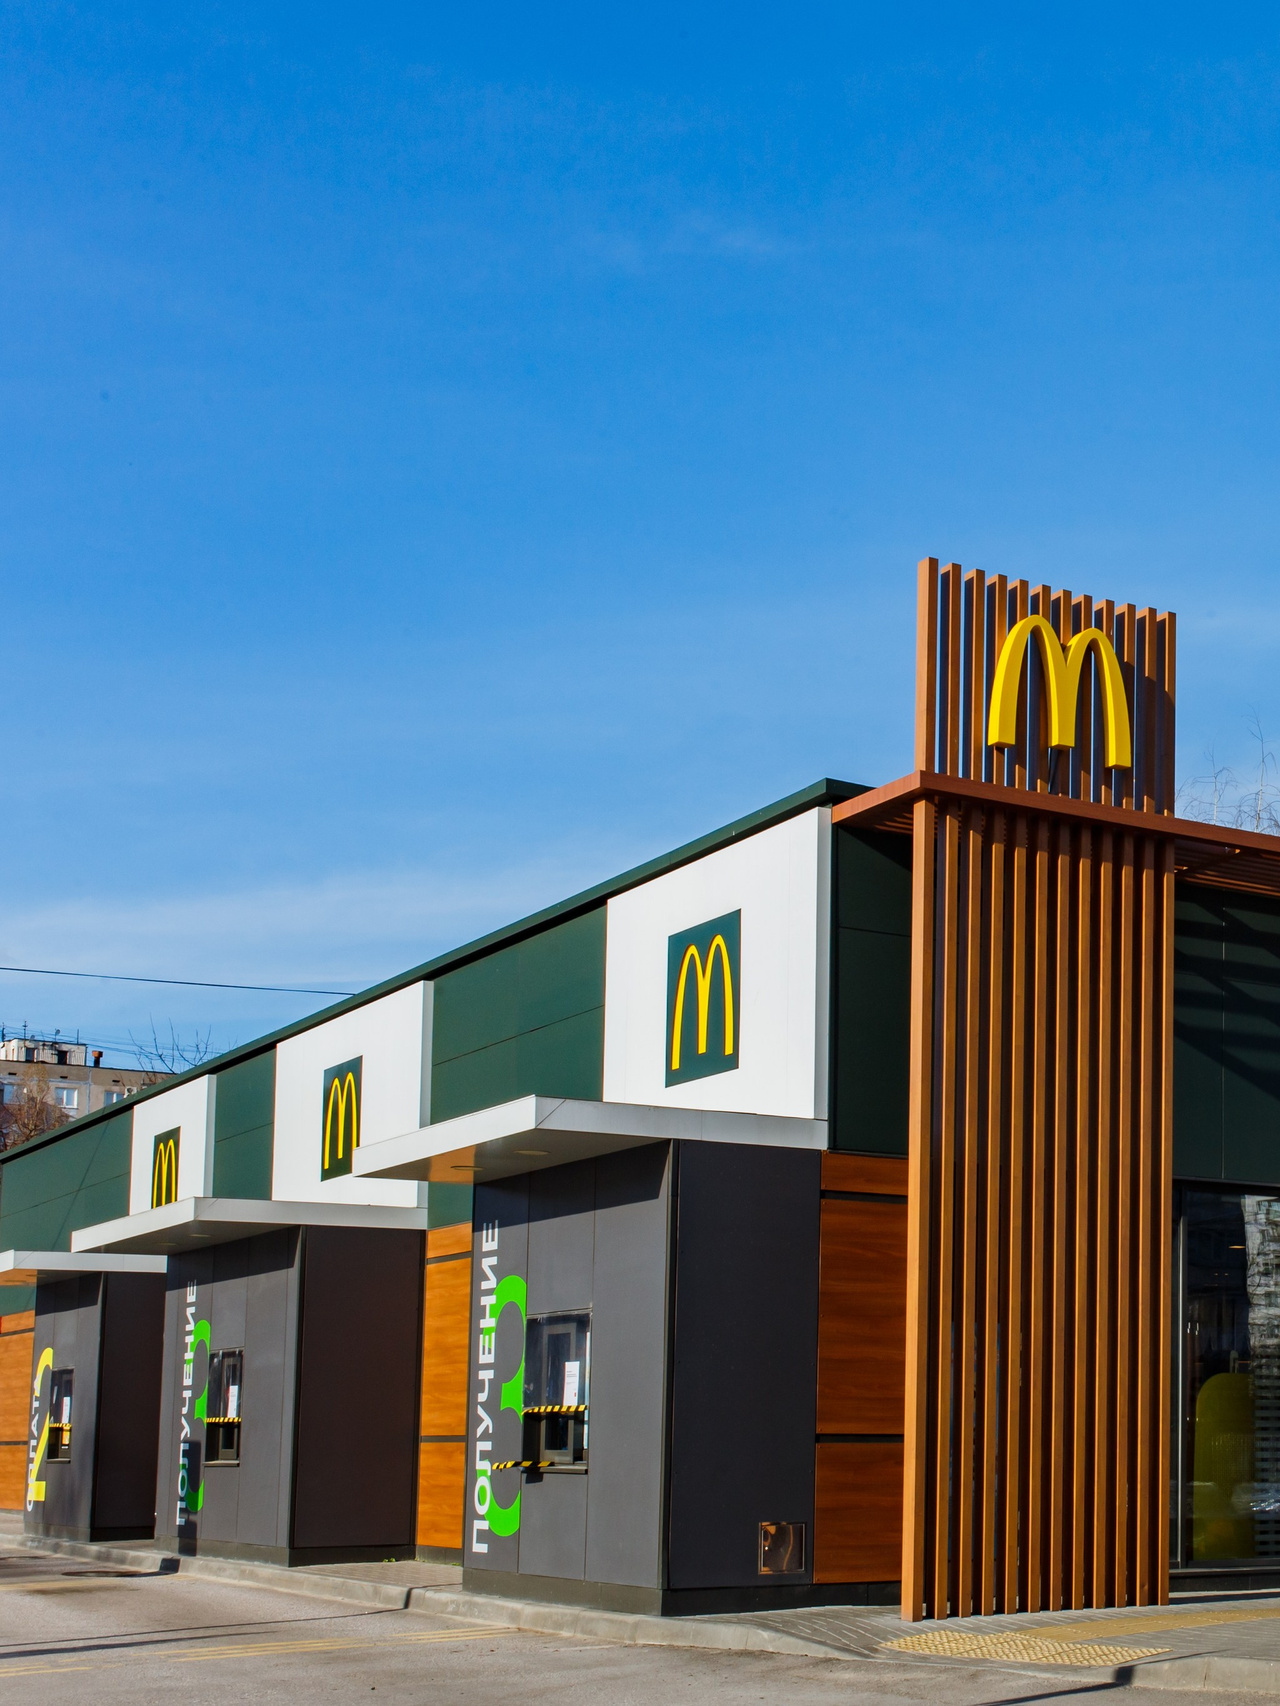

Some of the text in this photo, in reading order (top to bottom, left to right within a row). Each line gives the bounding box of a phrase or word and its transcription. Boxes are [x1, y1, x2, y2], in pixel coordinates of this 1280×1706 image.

[27, 1371, 41, 1512] ОПЛАТА
[176, 1279, 197, 1526] ПОЛУЧЕНИЕ
[472, 1219, 498, 1553] ПОЛУЧЕНИЕ
